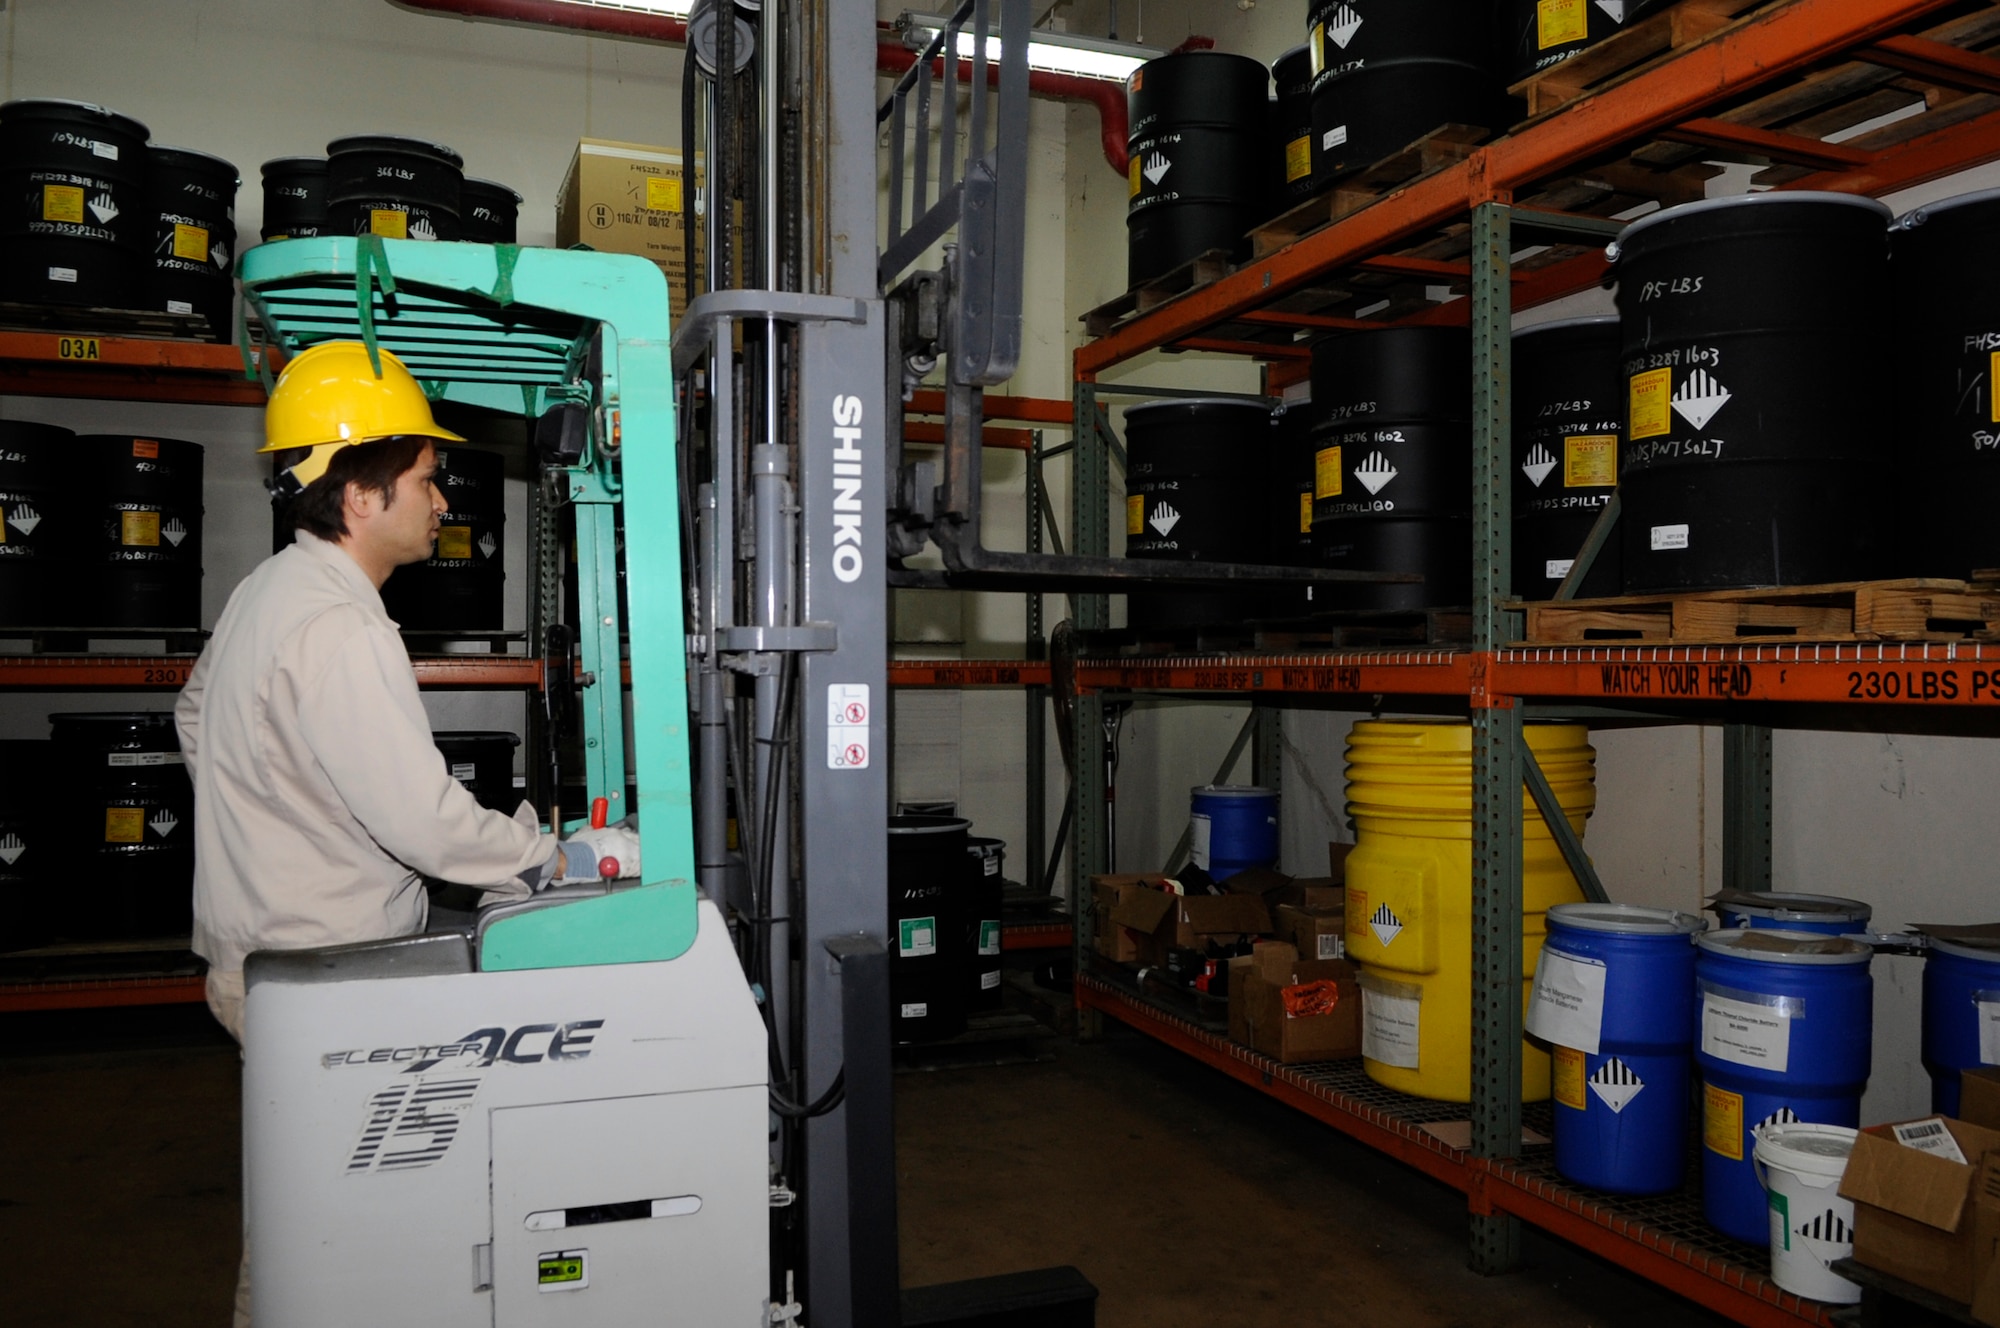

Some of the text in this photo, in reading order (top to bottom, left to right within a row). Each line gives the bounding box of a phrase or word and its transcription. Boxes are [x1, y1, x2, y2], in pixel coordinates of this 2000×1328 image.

[1639, 276, 1704, 303] 195 LBS
[60, 339, 98, 359] 03A
[1649, 349, 1680, 367] 3289
[1685, 345, 1719, 367] 1603
[1343, 432, 1367, 443] 3276
[1374, 431, 1405, 443] 1602
[1558, 422, 1588, 434] 3274
[832, 394, 863, 583] SHINKO
[144, 669, 176, 682] 230
[1195, 671, 1248, 688] 230 LBS PSF
[1282, 667, 1360, 690] WATCH YOUR HEAD
[1600, 664, 1752, 697] WATCH YOUR HEAD
[1847, 671, 1901, 699] 230
[1906, 671, 1959, 699] LBS
